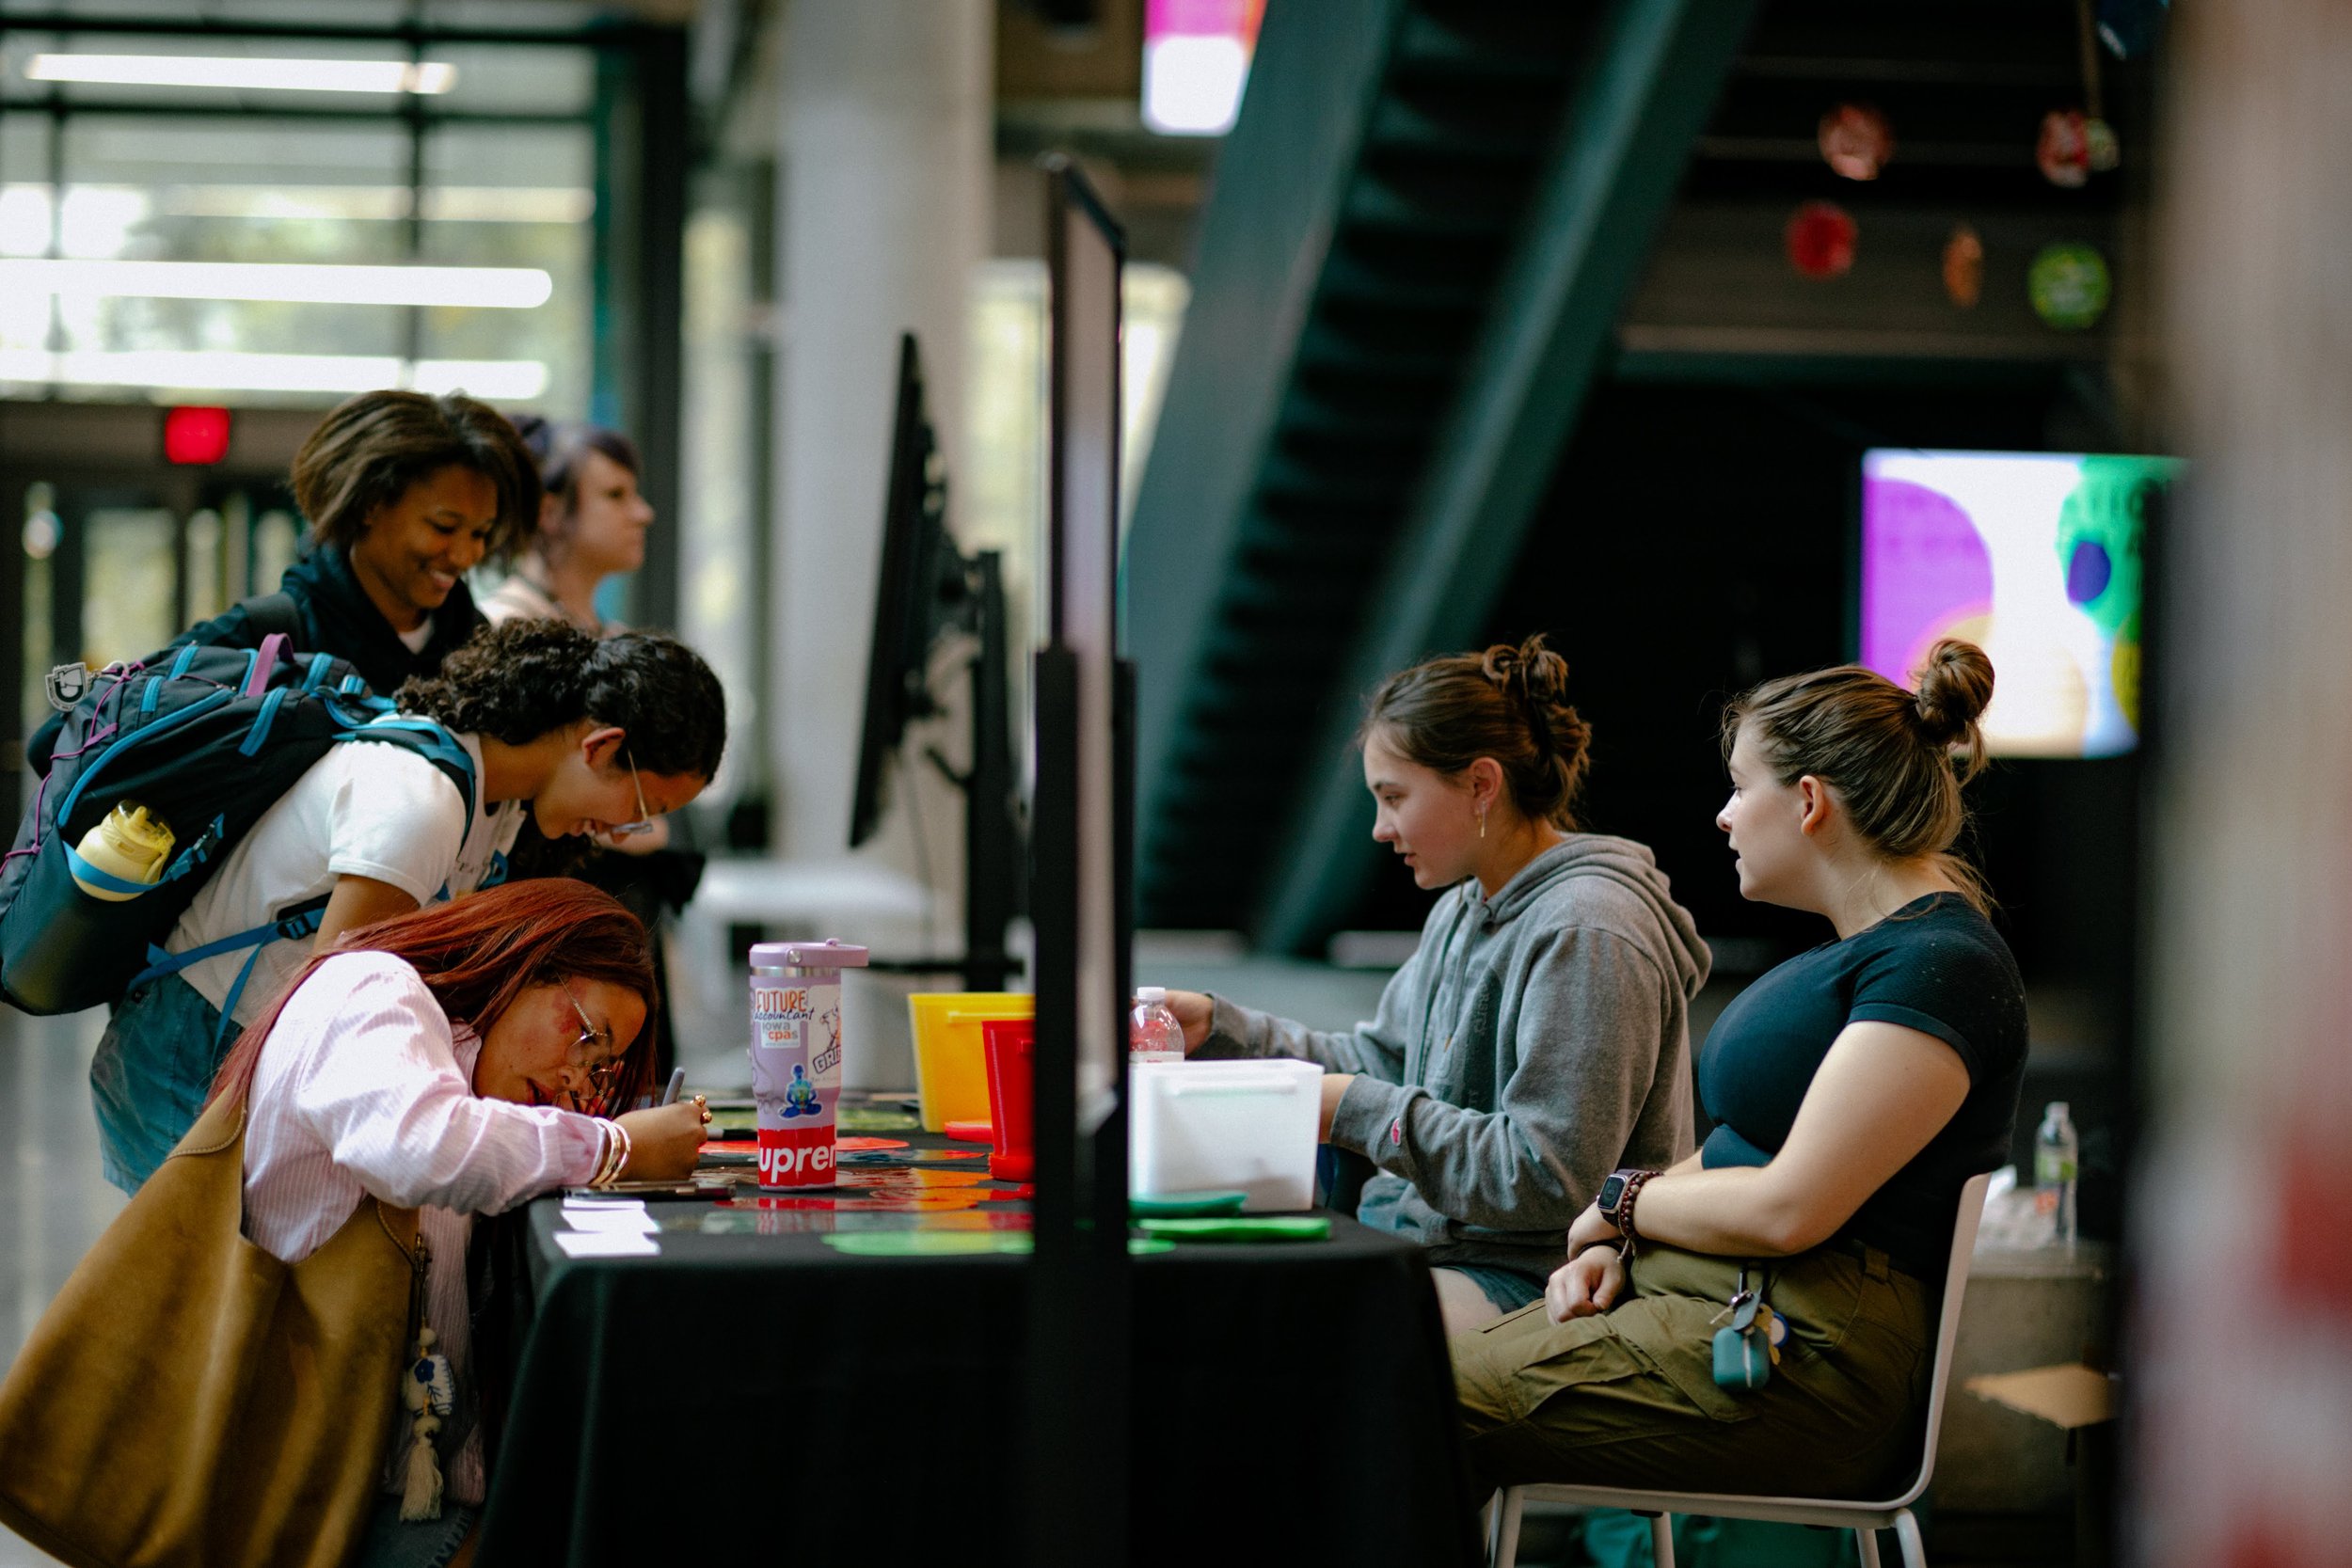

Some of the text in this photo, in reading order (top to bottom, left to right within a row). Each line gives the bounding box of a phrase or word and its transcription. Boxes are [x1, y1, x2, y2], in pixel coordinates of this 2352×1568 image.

[755, 990, 806, 1012] FUTURE
[754, 1006, 815, 1021] accountant
[762, 1022, 791, 1031] iowa
[768, 1030, 799, 1041] cpas
[758, 1144, 835, 1183] upre
